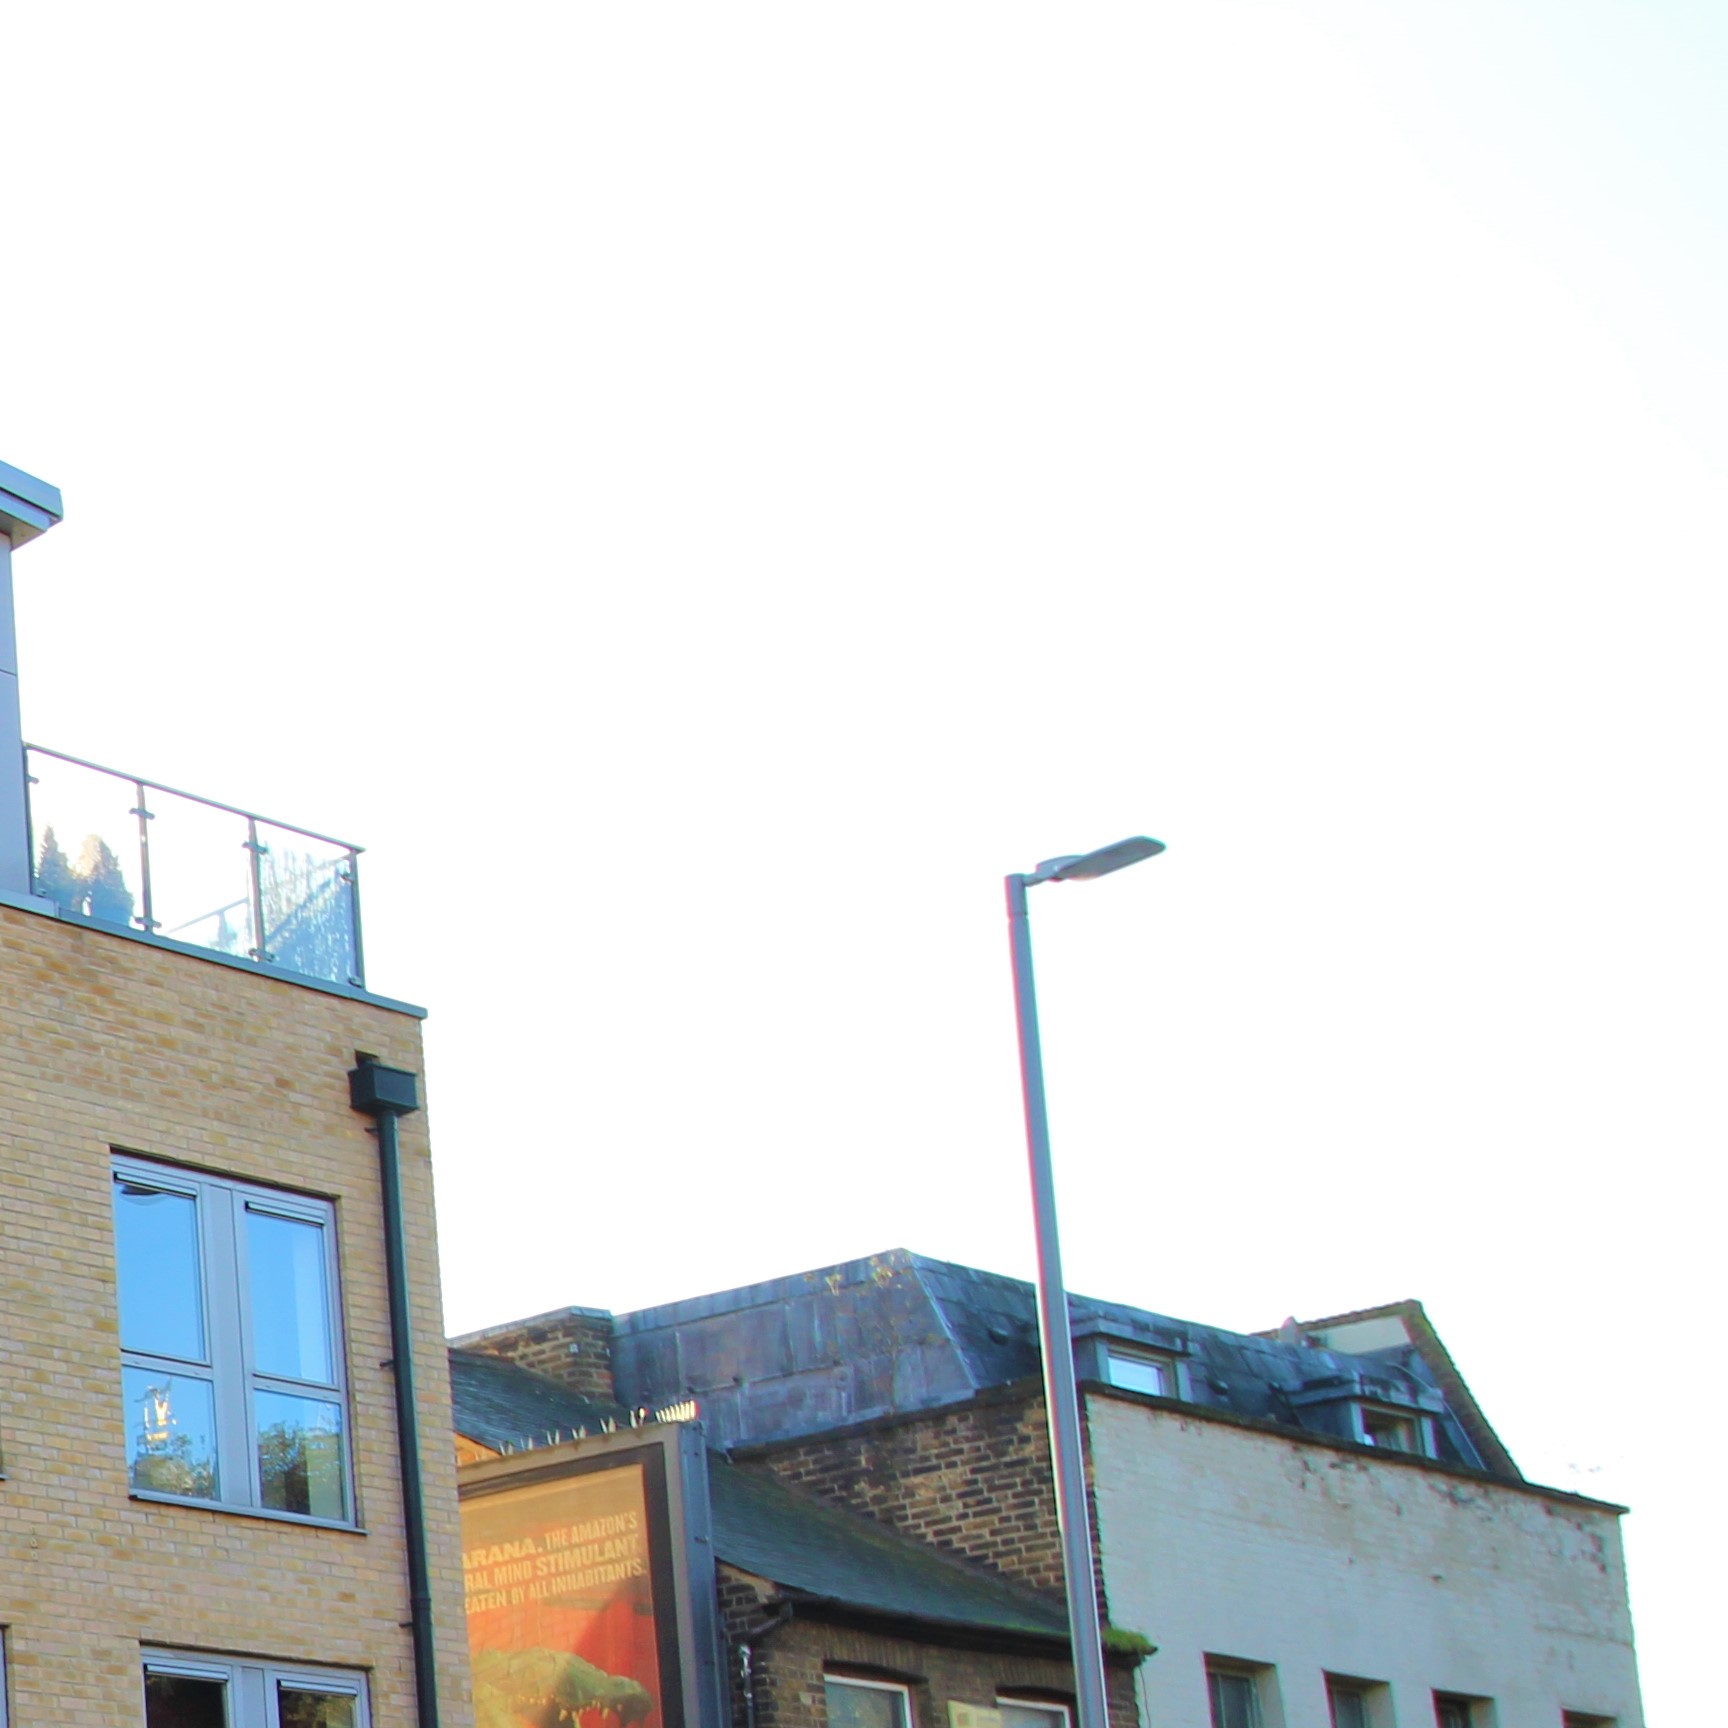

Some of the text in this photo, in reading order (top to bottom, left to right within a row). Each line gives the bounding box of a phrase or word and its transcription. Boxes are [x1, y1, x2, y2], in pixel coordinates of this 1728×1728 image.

[545, 1528, 570, 1550] THE
[571, 1511, 637, 1545] AMAZON'S
[494, 1560, 533, 1587] MIND
[510, 1586, 525, 1606] BY
[528, 1580, 549, 1601] ALL
[551, 1557, 648, 1597] INHABITANTS.
